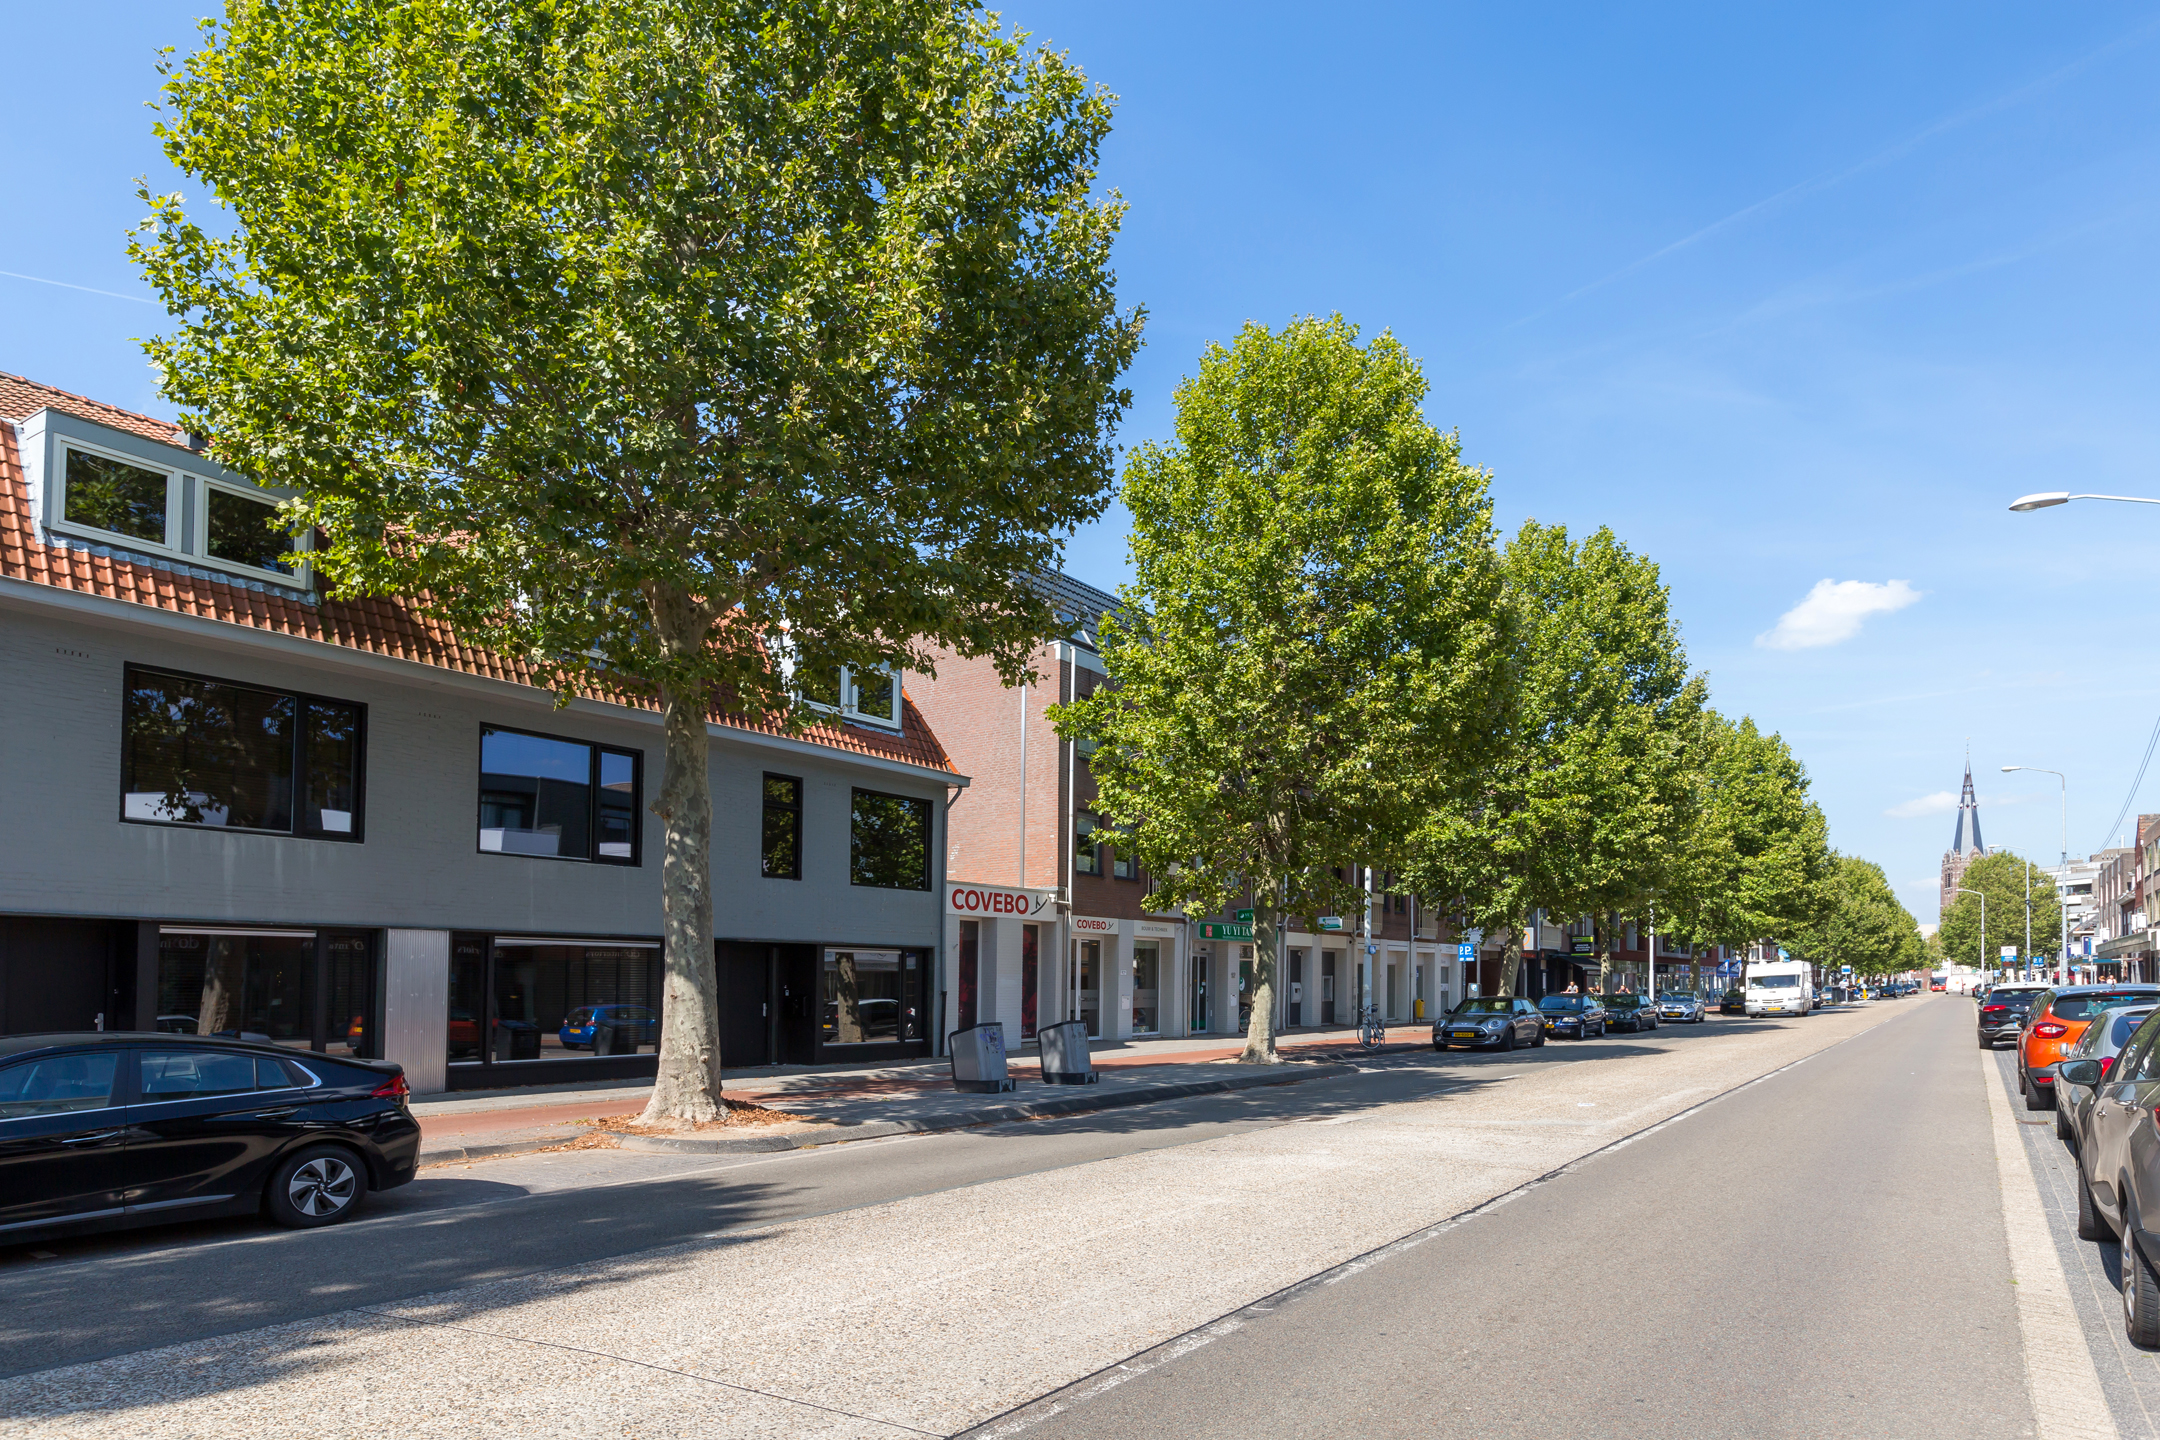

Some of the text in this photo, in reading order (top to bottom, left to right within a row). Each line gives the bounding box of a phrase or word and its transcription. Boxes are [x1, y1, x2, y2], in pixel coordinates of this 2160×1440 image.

[952, 889, 1029, 915] COVEBO
[1077, 919, 1107, 931] COVEBO
[1222, 925, 1232, 936] YU
[1233, 926, 1240, 936] YI
